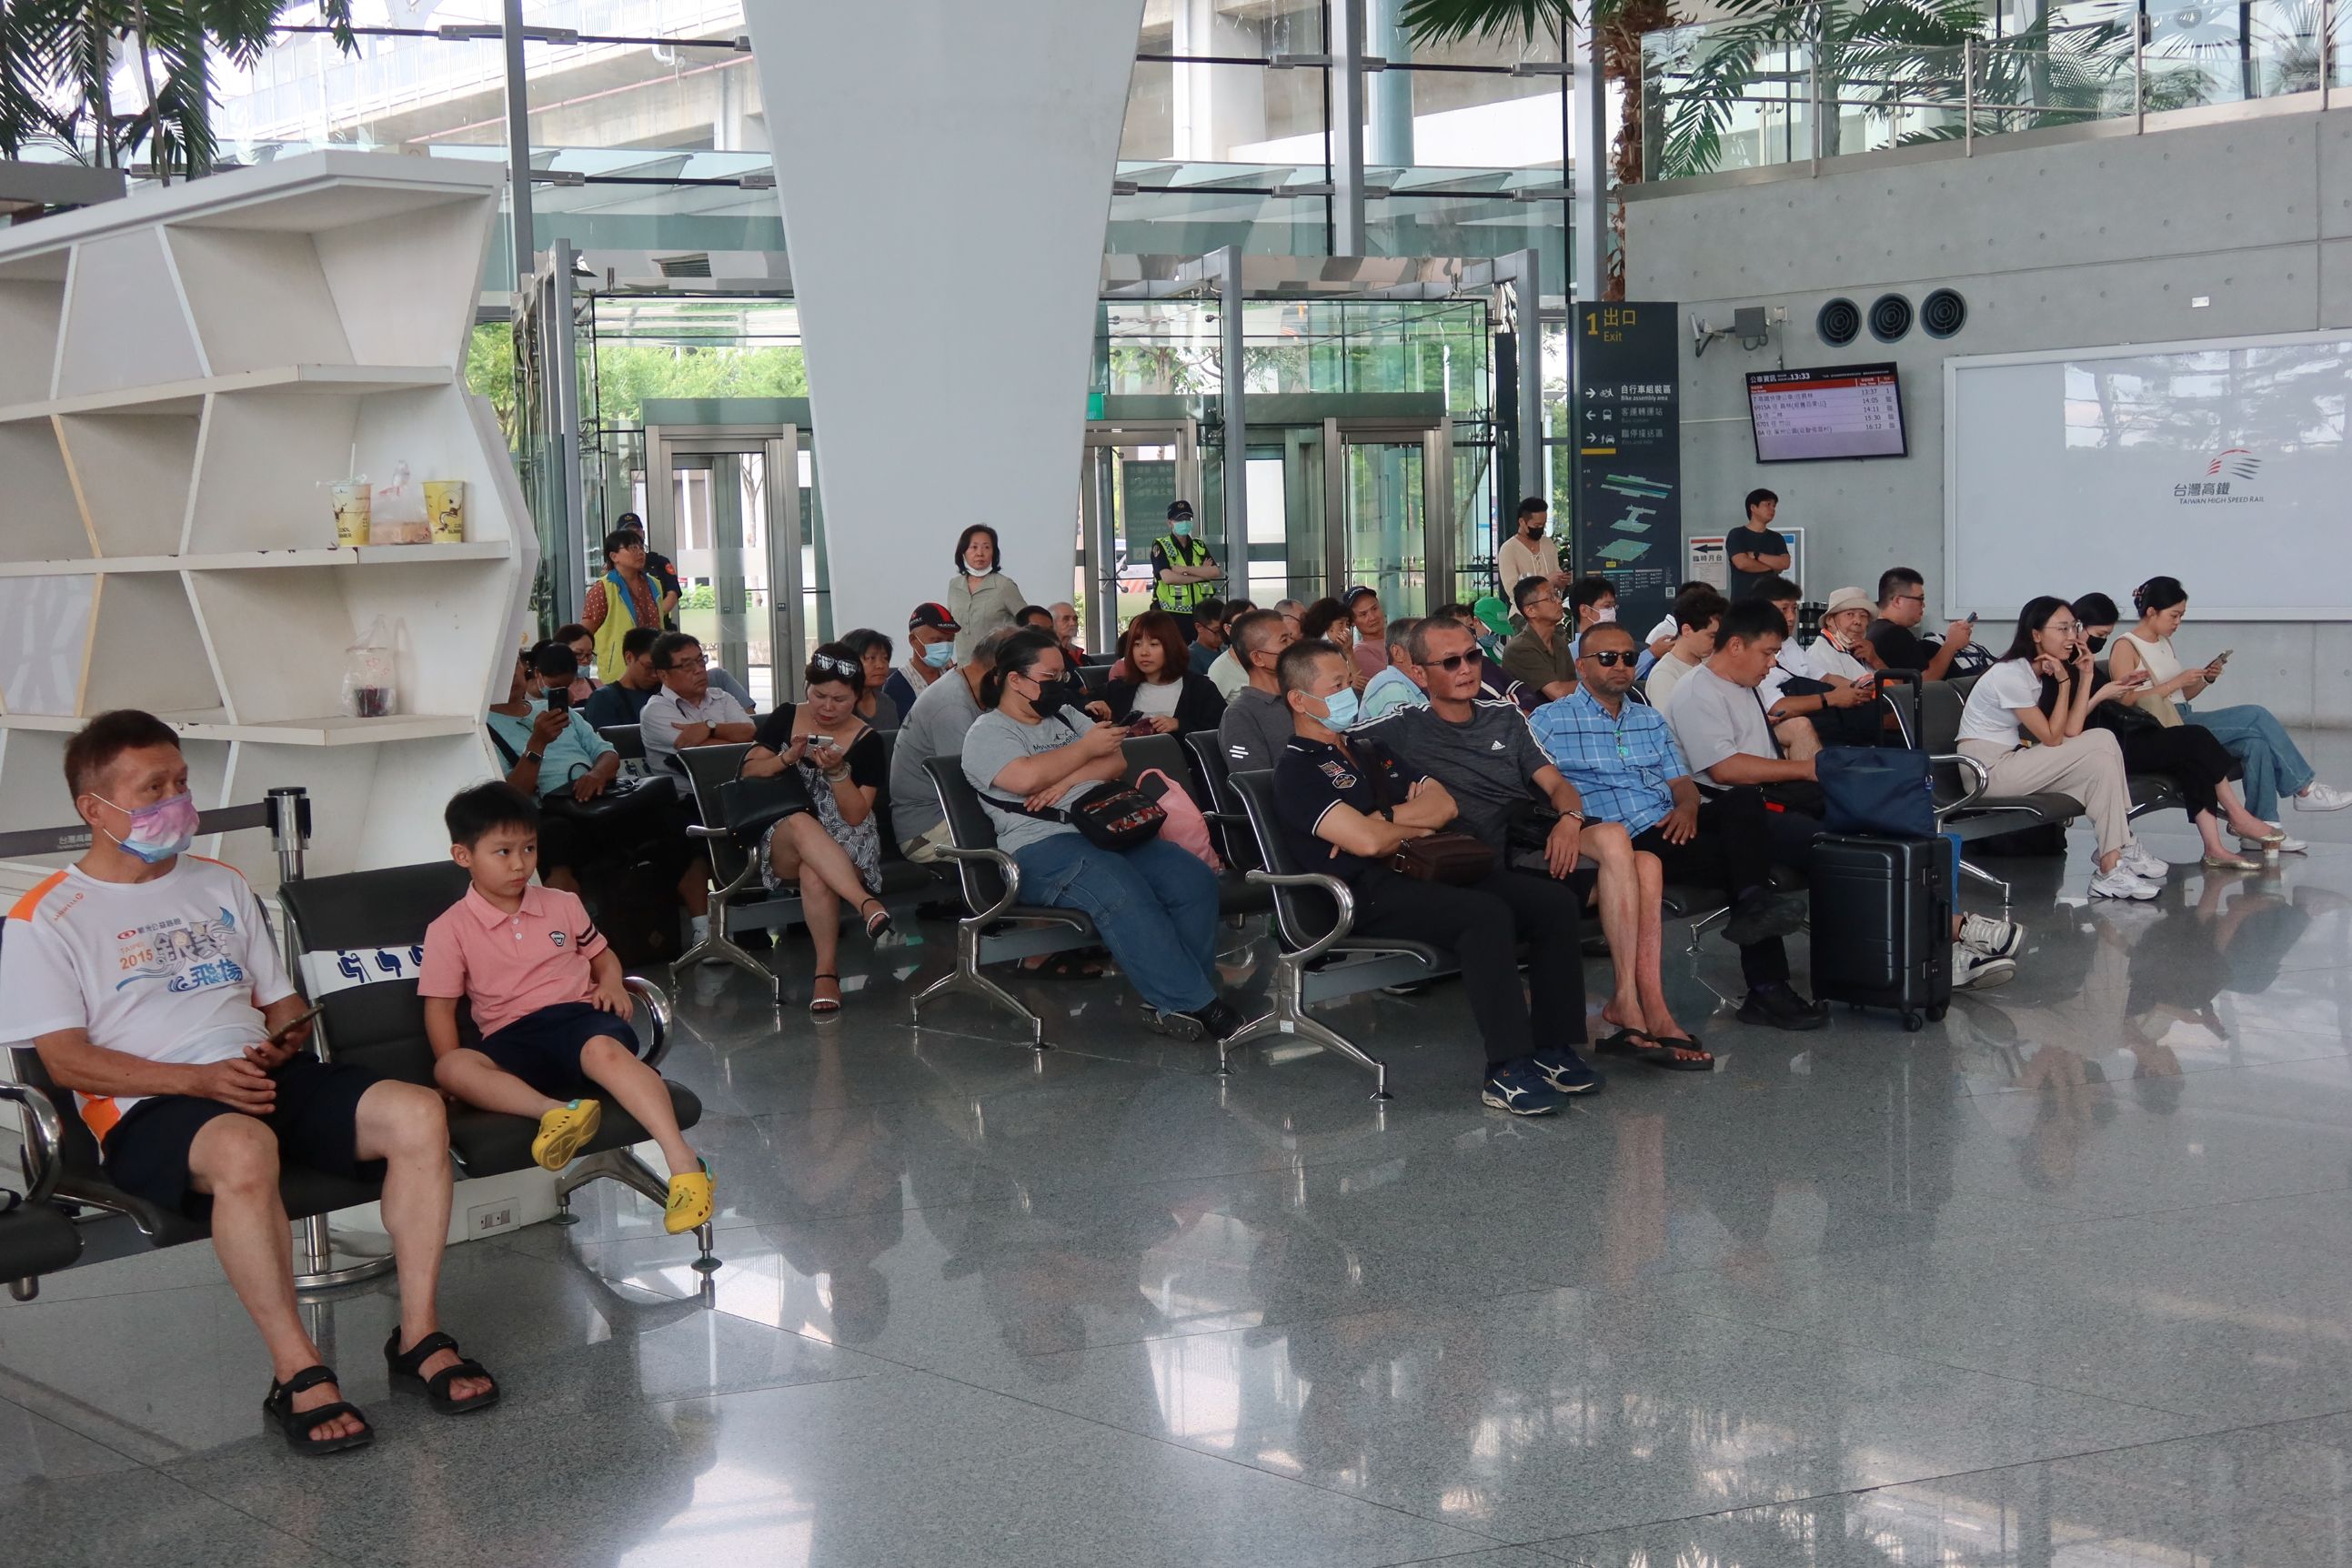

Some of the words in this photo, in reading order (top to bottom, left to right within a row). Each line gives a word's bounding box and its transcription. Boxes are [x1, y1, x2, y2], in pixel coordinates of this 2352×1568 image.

[1586, 312, 1599, 336] 1
[1603, 307, 1637, 327] 出口
[1603, 331, 1623, 343] Exit
[1790, 372, 1811, 381] 13:33
[1621, 384, 1672, 395] 自行車組裝區
[2174, 482, 2231, 497] 台灣高鐵
[1693, 554, 1723, 562] 臨時月台
[119, 949, 155, 970] 2015
